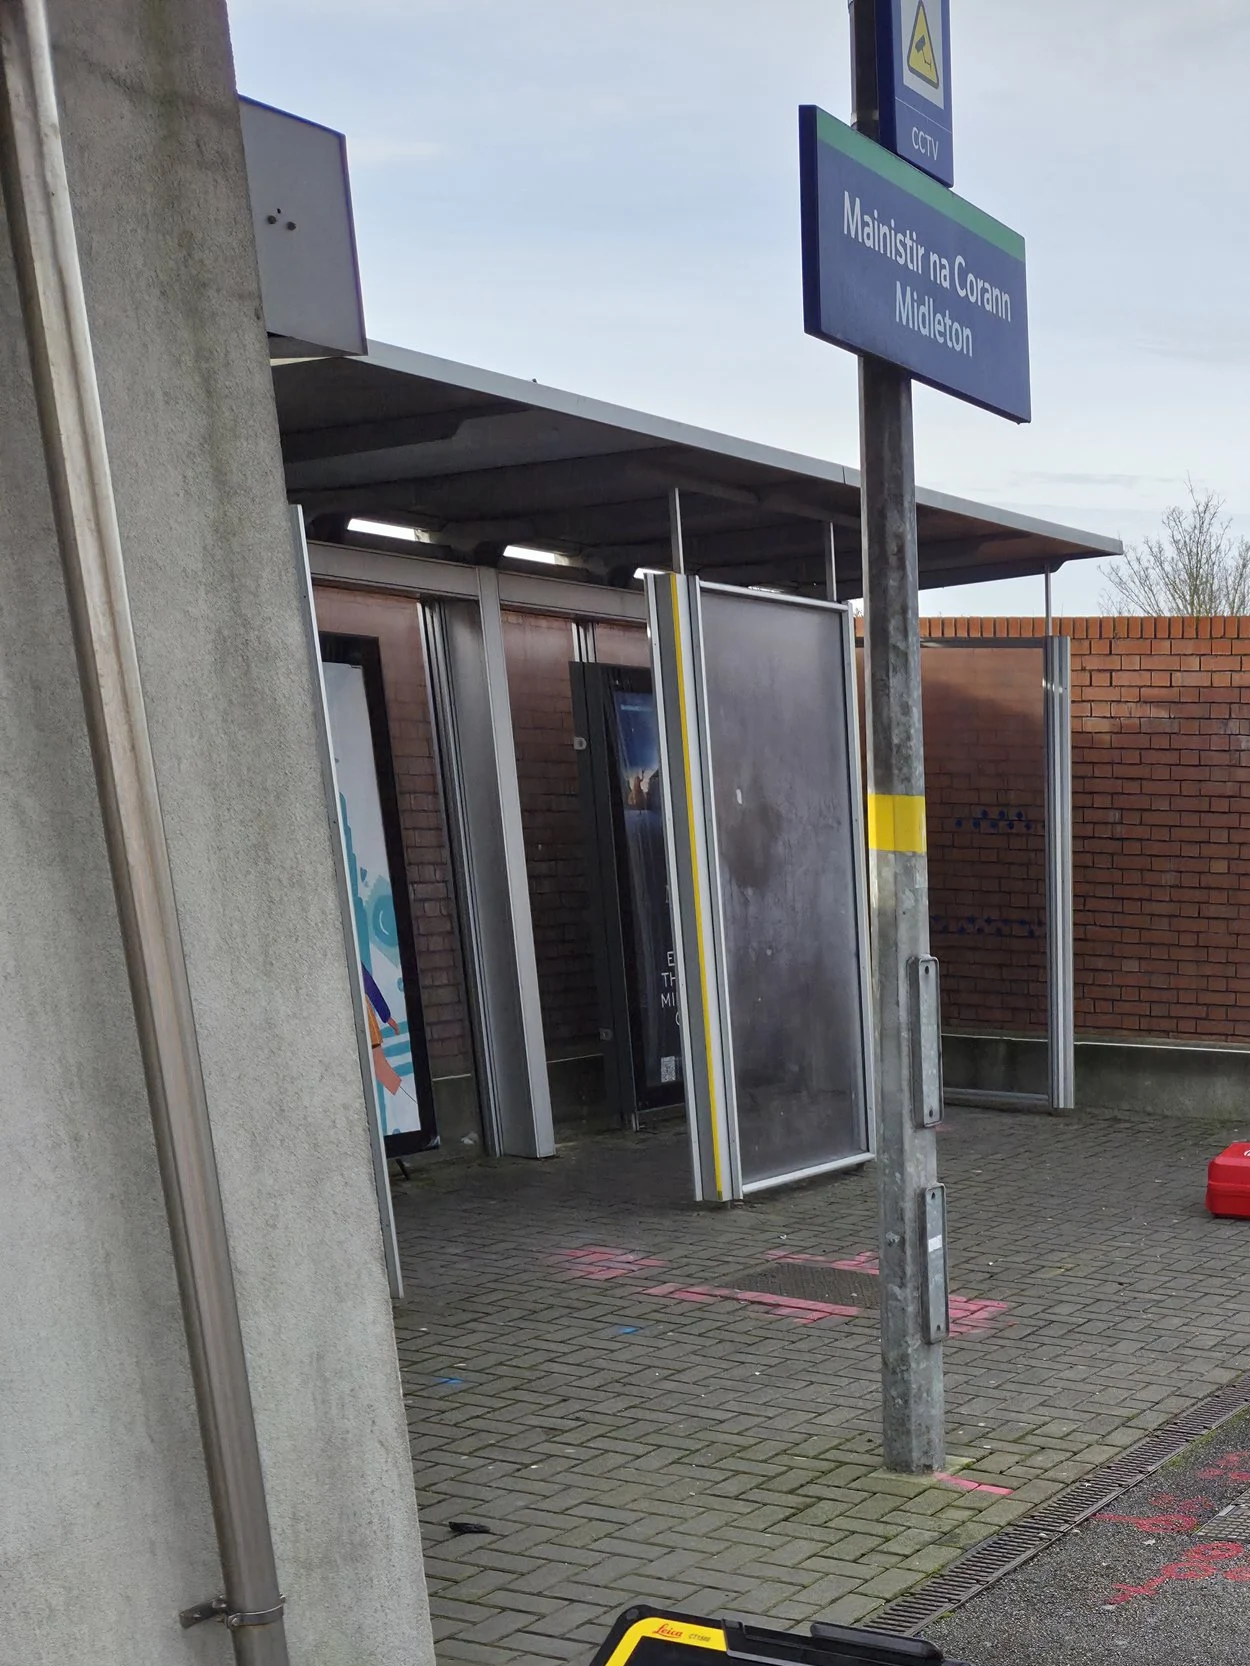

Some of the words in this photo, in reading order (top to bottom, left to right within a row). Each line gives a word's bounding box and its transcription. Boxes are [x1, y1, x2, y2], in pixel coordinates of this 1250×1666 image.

[912, 127, 938, 160] CCTV
[843, 190, 924, 274] Mainistir
[930, 251, 950, 289] na
[954, 255, 1011, 322] Corann
[895, 281, 972, 358] Midleton
[652, 1623, 683, 1638] Leica
